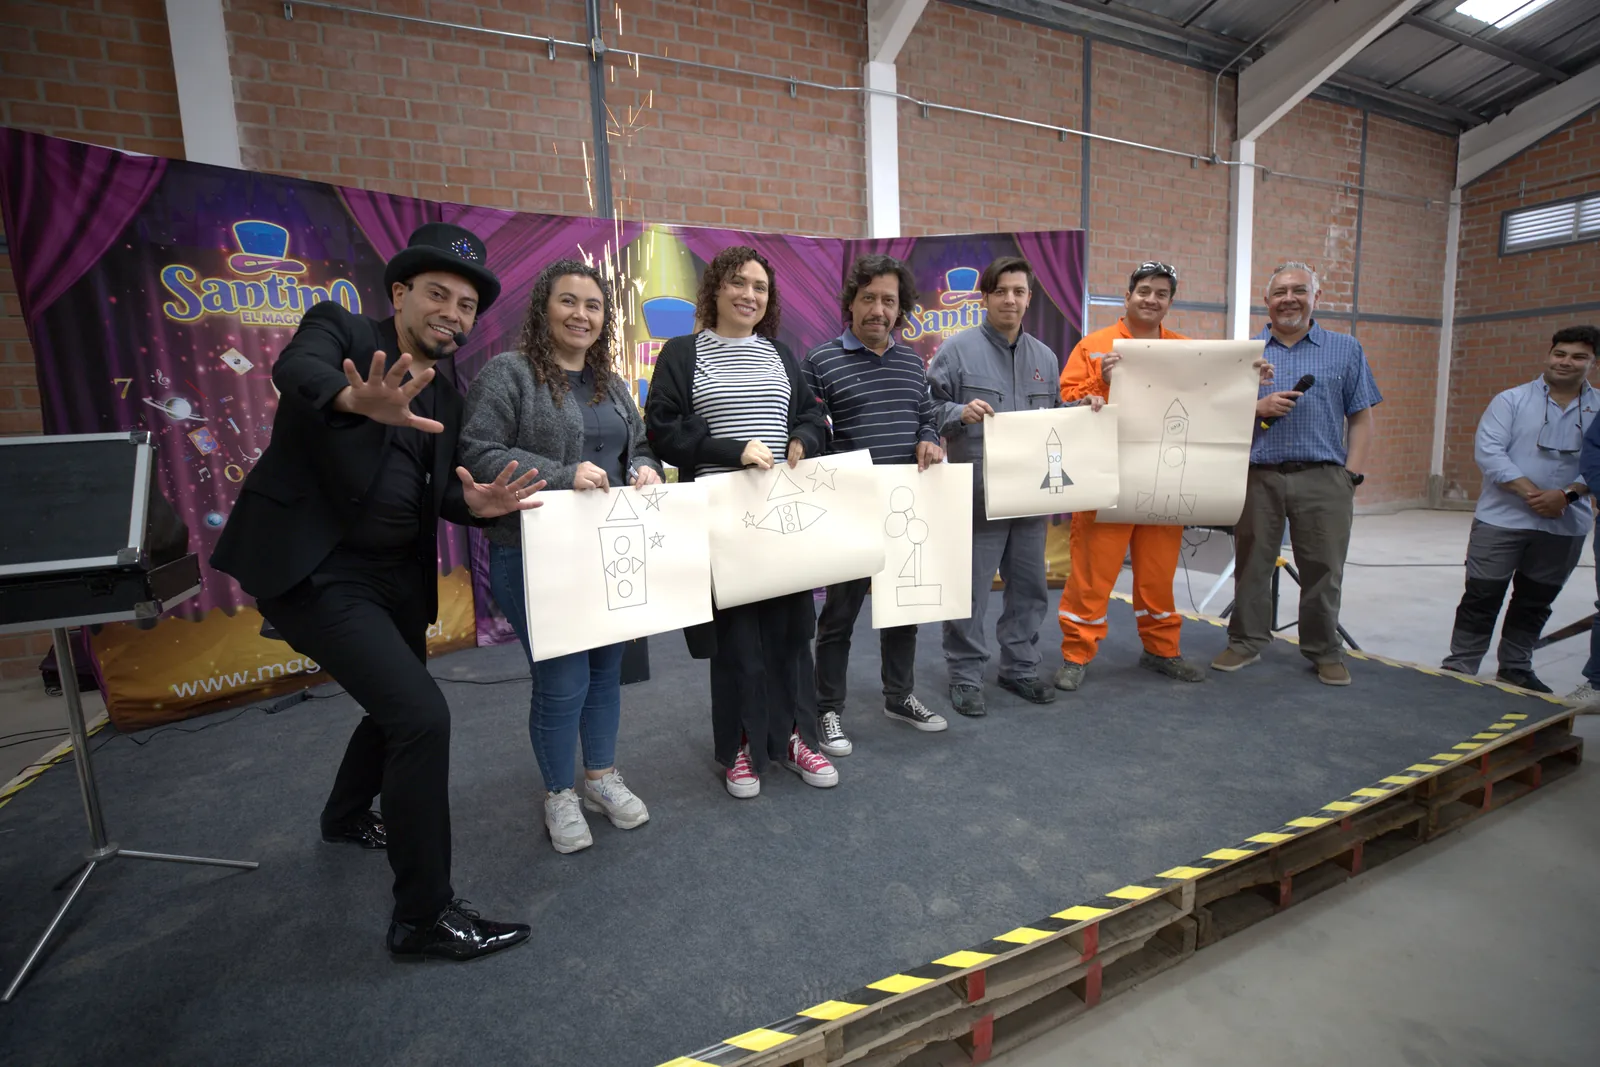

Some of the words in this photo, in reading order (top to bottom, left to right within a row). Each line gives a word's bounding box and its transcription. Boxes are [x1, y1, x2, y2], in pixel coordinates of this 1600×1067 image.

[161, 264, 362, 322] Santino
[242, 311, 259, 322] EL
[262, 312, 302, 325] MAGO
[114, 378, 133, 399] 7
[172, 657, 321, 698] www.mag
